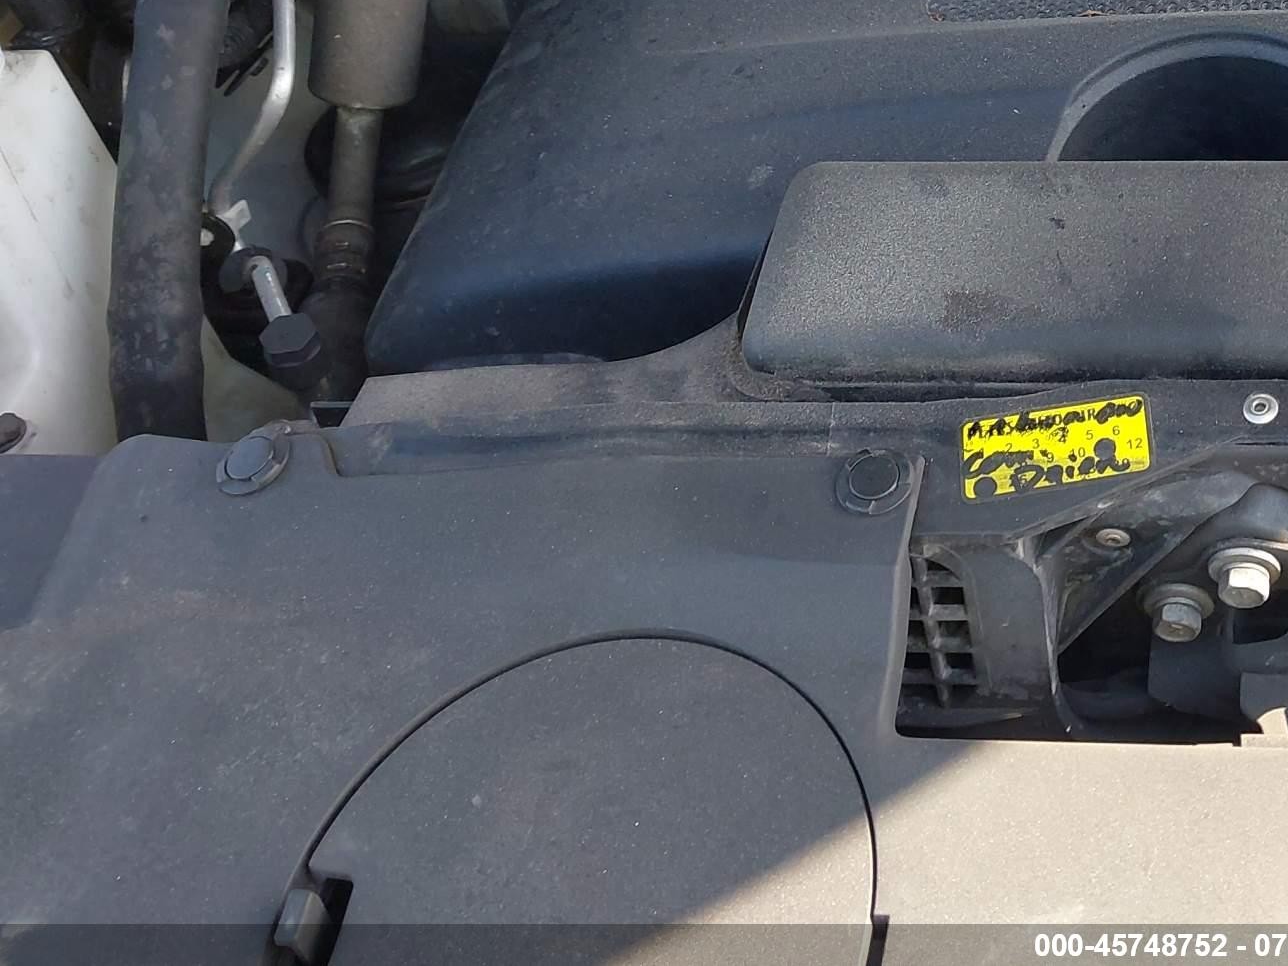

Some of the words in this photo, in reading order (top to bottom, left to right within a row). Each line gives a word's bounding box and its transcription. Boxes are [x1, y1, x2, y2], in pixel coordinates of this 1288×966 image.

[1031, 438, 1040, 450] 3
[1085, 429, 1094, 441] 5
[1112, 425, 1121, 436] 6
[1046, 451, 1055, 463] 9
[1126, 437, 1143, 450] 12
